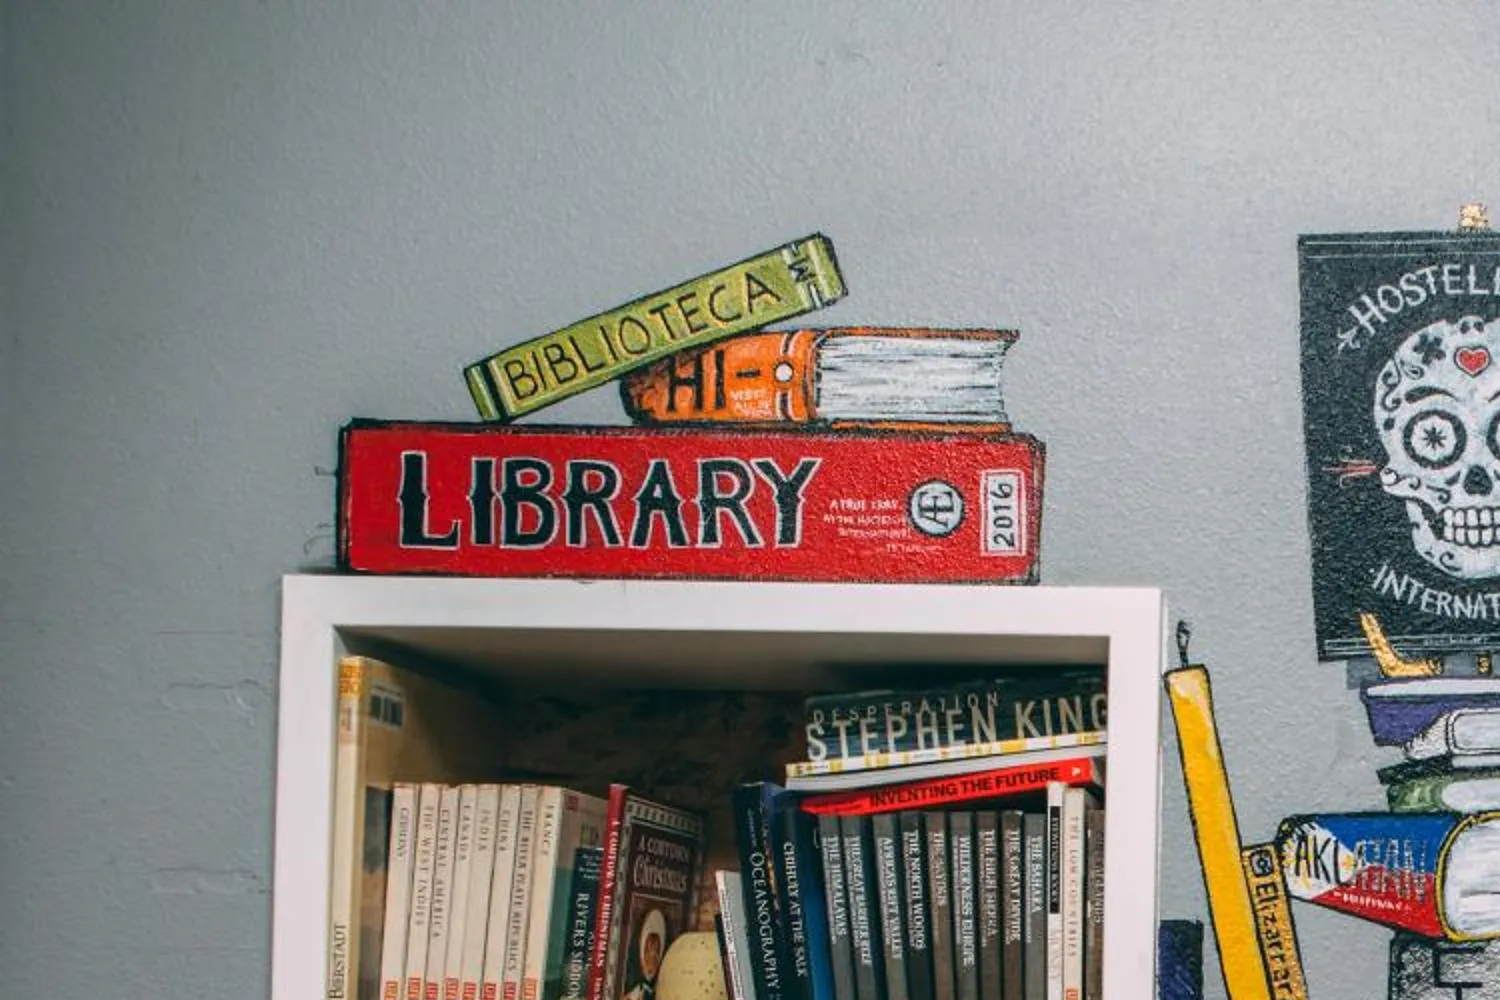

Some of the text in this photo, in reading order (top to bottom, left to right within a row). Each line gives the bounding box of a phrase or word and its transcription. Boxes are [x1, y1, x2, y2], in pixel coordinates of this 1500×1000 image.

[504, 271, 782, 402] BIBLIOTECA
[399, 449, 823, 551] LIBRARY
[989, 482, 1016, 548] 2016
[806, 694, 1108, 761] STEPHEN KING
[812, 691, 999, 726] DESPERATION
[869, 767, 1061, 808] INVENTING THE FUTURE
[458, 805, 473, 862] CANADA
[850, 836, 862, 855] THE
[1008, 829, 1020, 852] THE
[506, 809, 534, 972] THE RIVER PLATE REPUBLICS
[783, 842, 803, 943] CHIHULY AT THE
[827, 837, 846, 935] THE HIMALAYAS
[852, 855, 865, 893] GREAT
[907, 831, 926, 950] THE NORTH WOODS
[958, 836, 974, 915] WILDERNESS
[1009, 856, 1021, 896] GREAT
[1031, 836, 1044, 913] THE SAHARA
[573, 892, 589, 947] RIVERS
[750, 852, 780, 989] OCEANOGRAPHY
[328, 924, 344, 999] BIERSTADT
